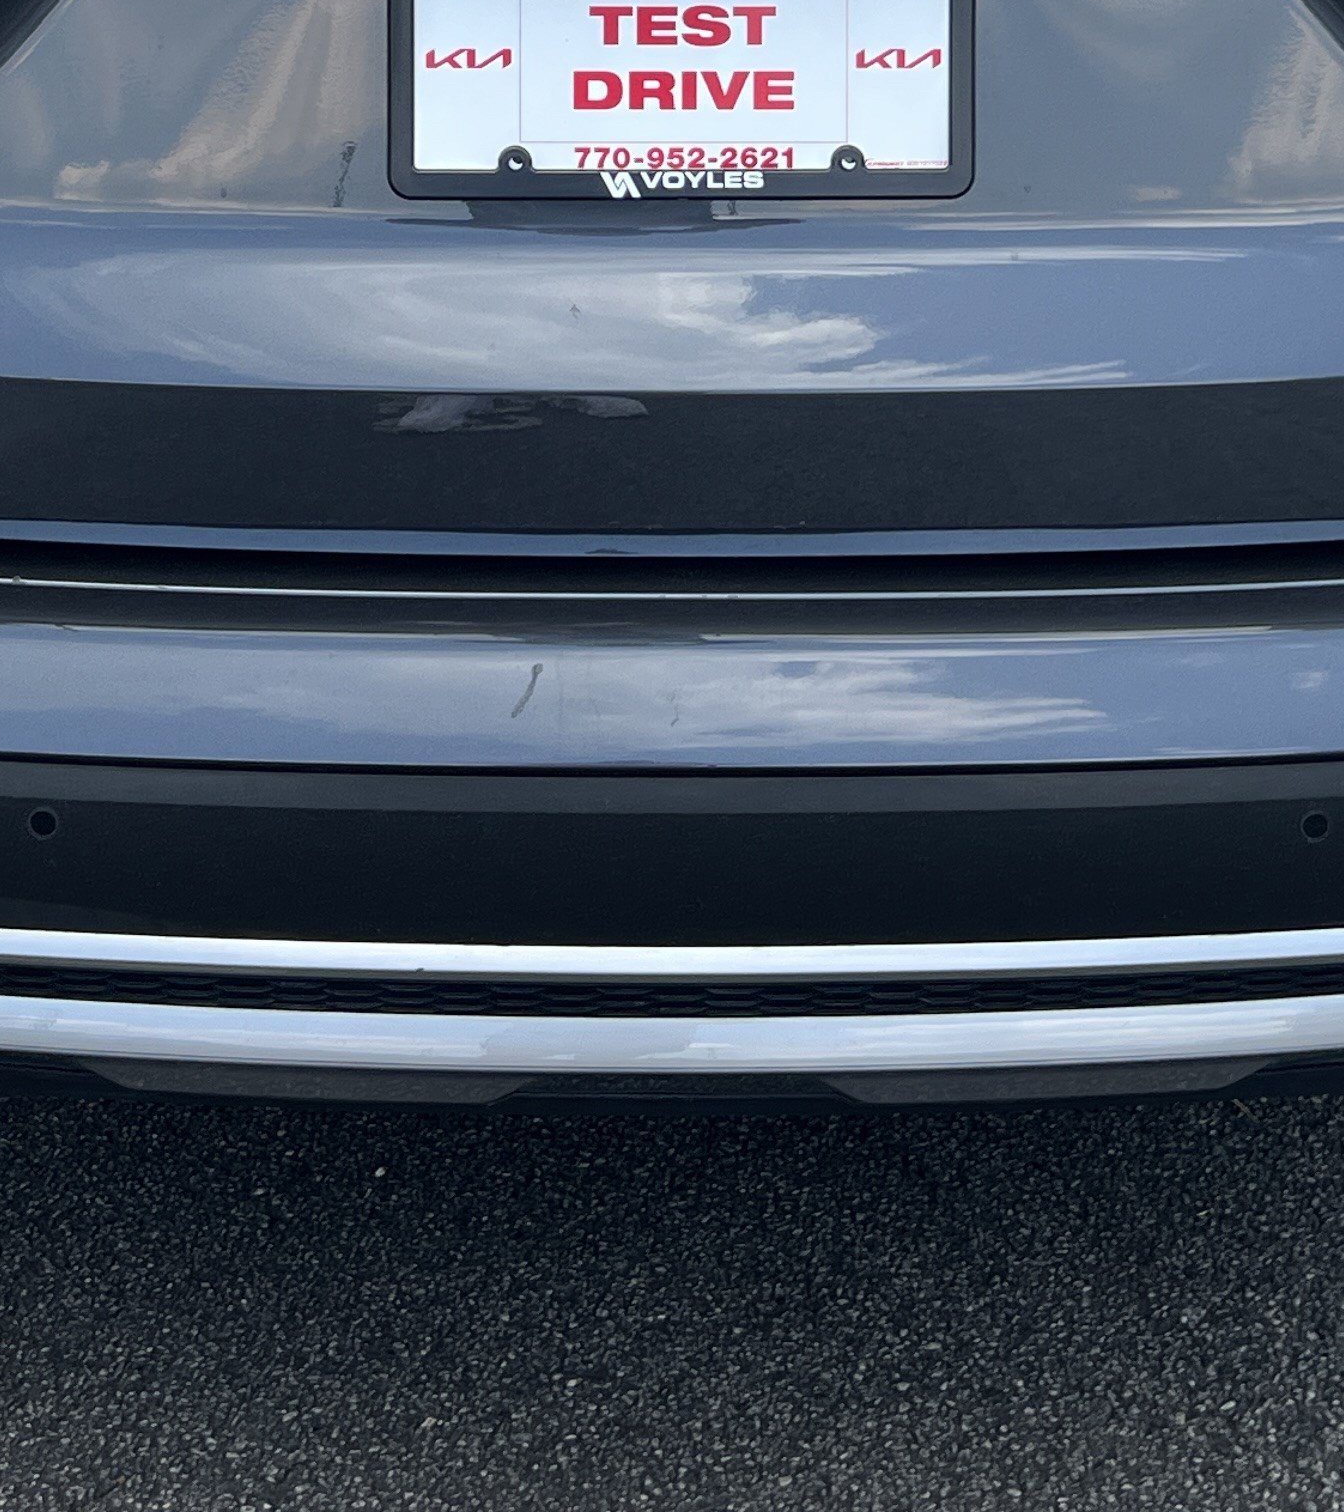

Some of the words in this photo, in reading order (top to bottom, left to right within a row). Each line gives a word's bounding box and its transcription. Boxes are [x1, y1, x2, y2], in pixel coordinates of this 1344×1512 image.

[589, 5, 776, 47] TEST
[425, 48, 513, 69] KIA
[855, 48, 942, 69] KIA
[573, 71, 795, 110] DRIVE
[574, 146, 794, 170] 770-952-2621
[641, 171, 764, 189] VOYLES
